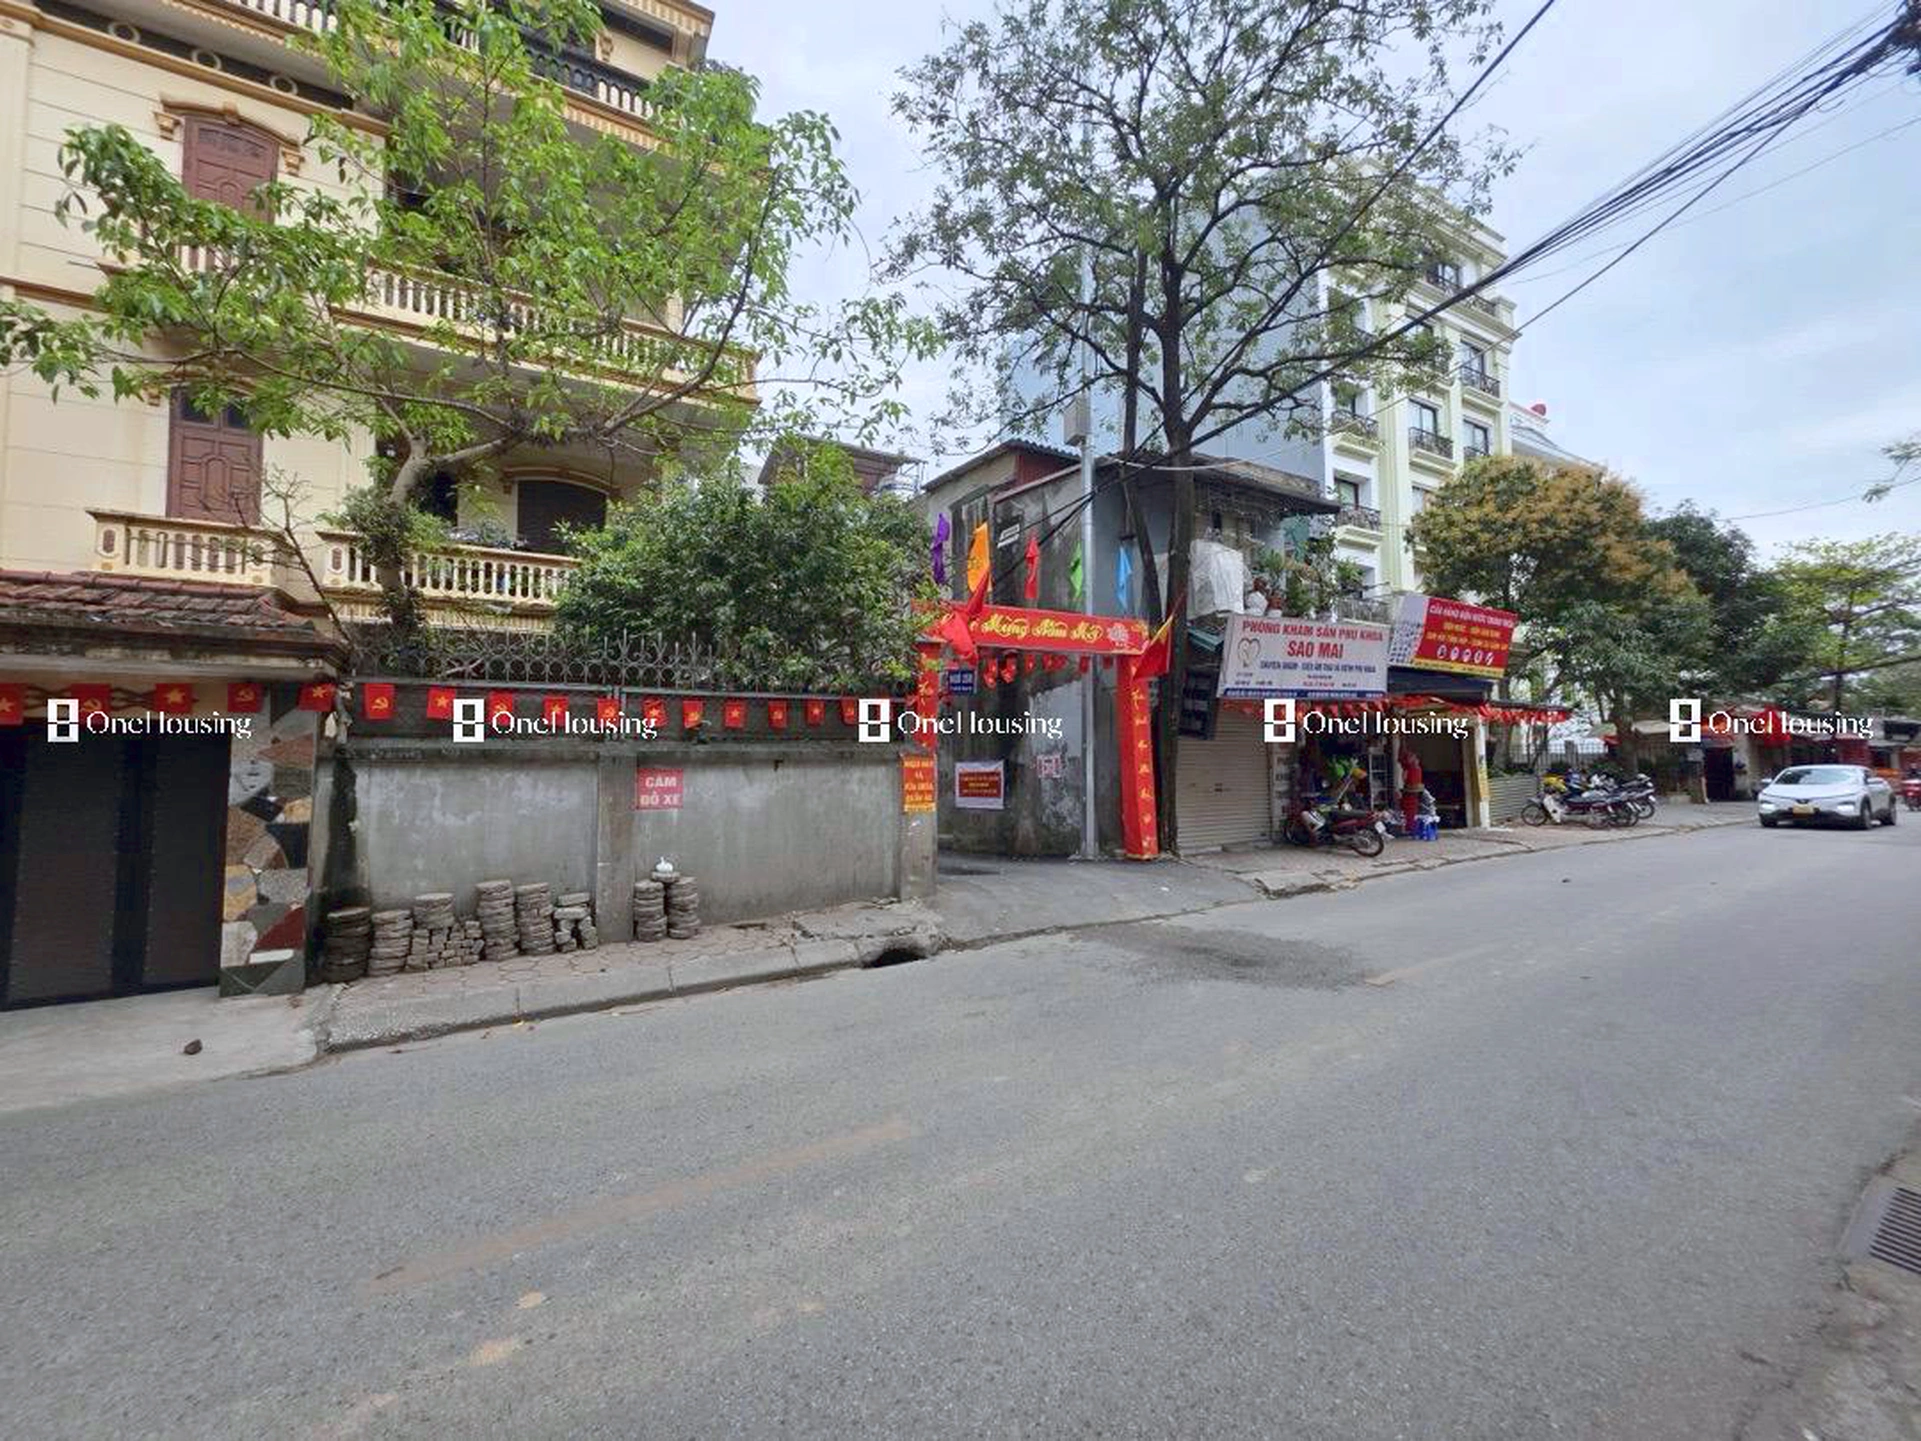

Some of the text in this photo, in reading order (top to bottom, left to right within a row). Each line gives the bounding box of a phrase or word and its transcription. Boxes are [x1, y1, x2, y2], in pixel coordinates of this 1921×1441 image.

[1287, 640, 1344, 659] SAO MAI
[663, 793, 681, 805] XE
